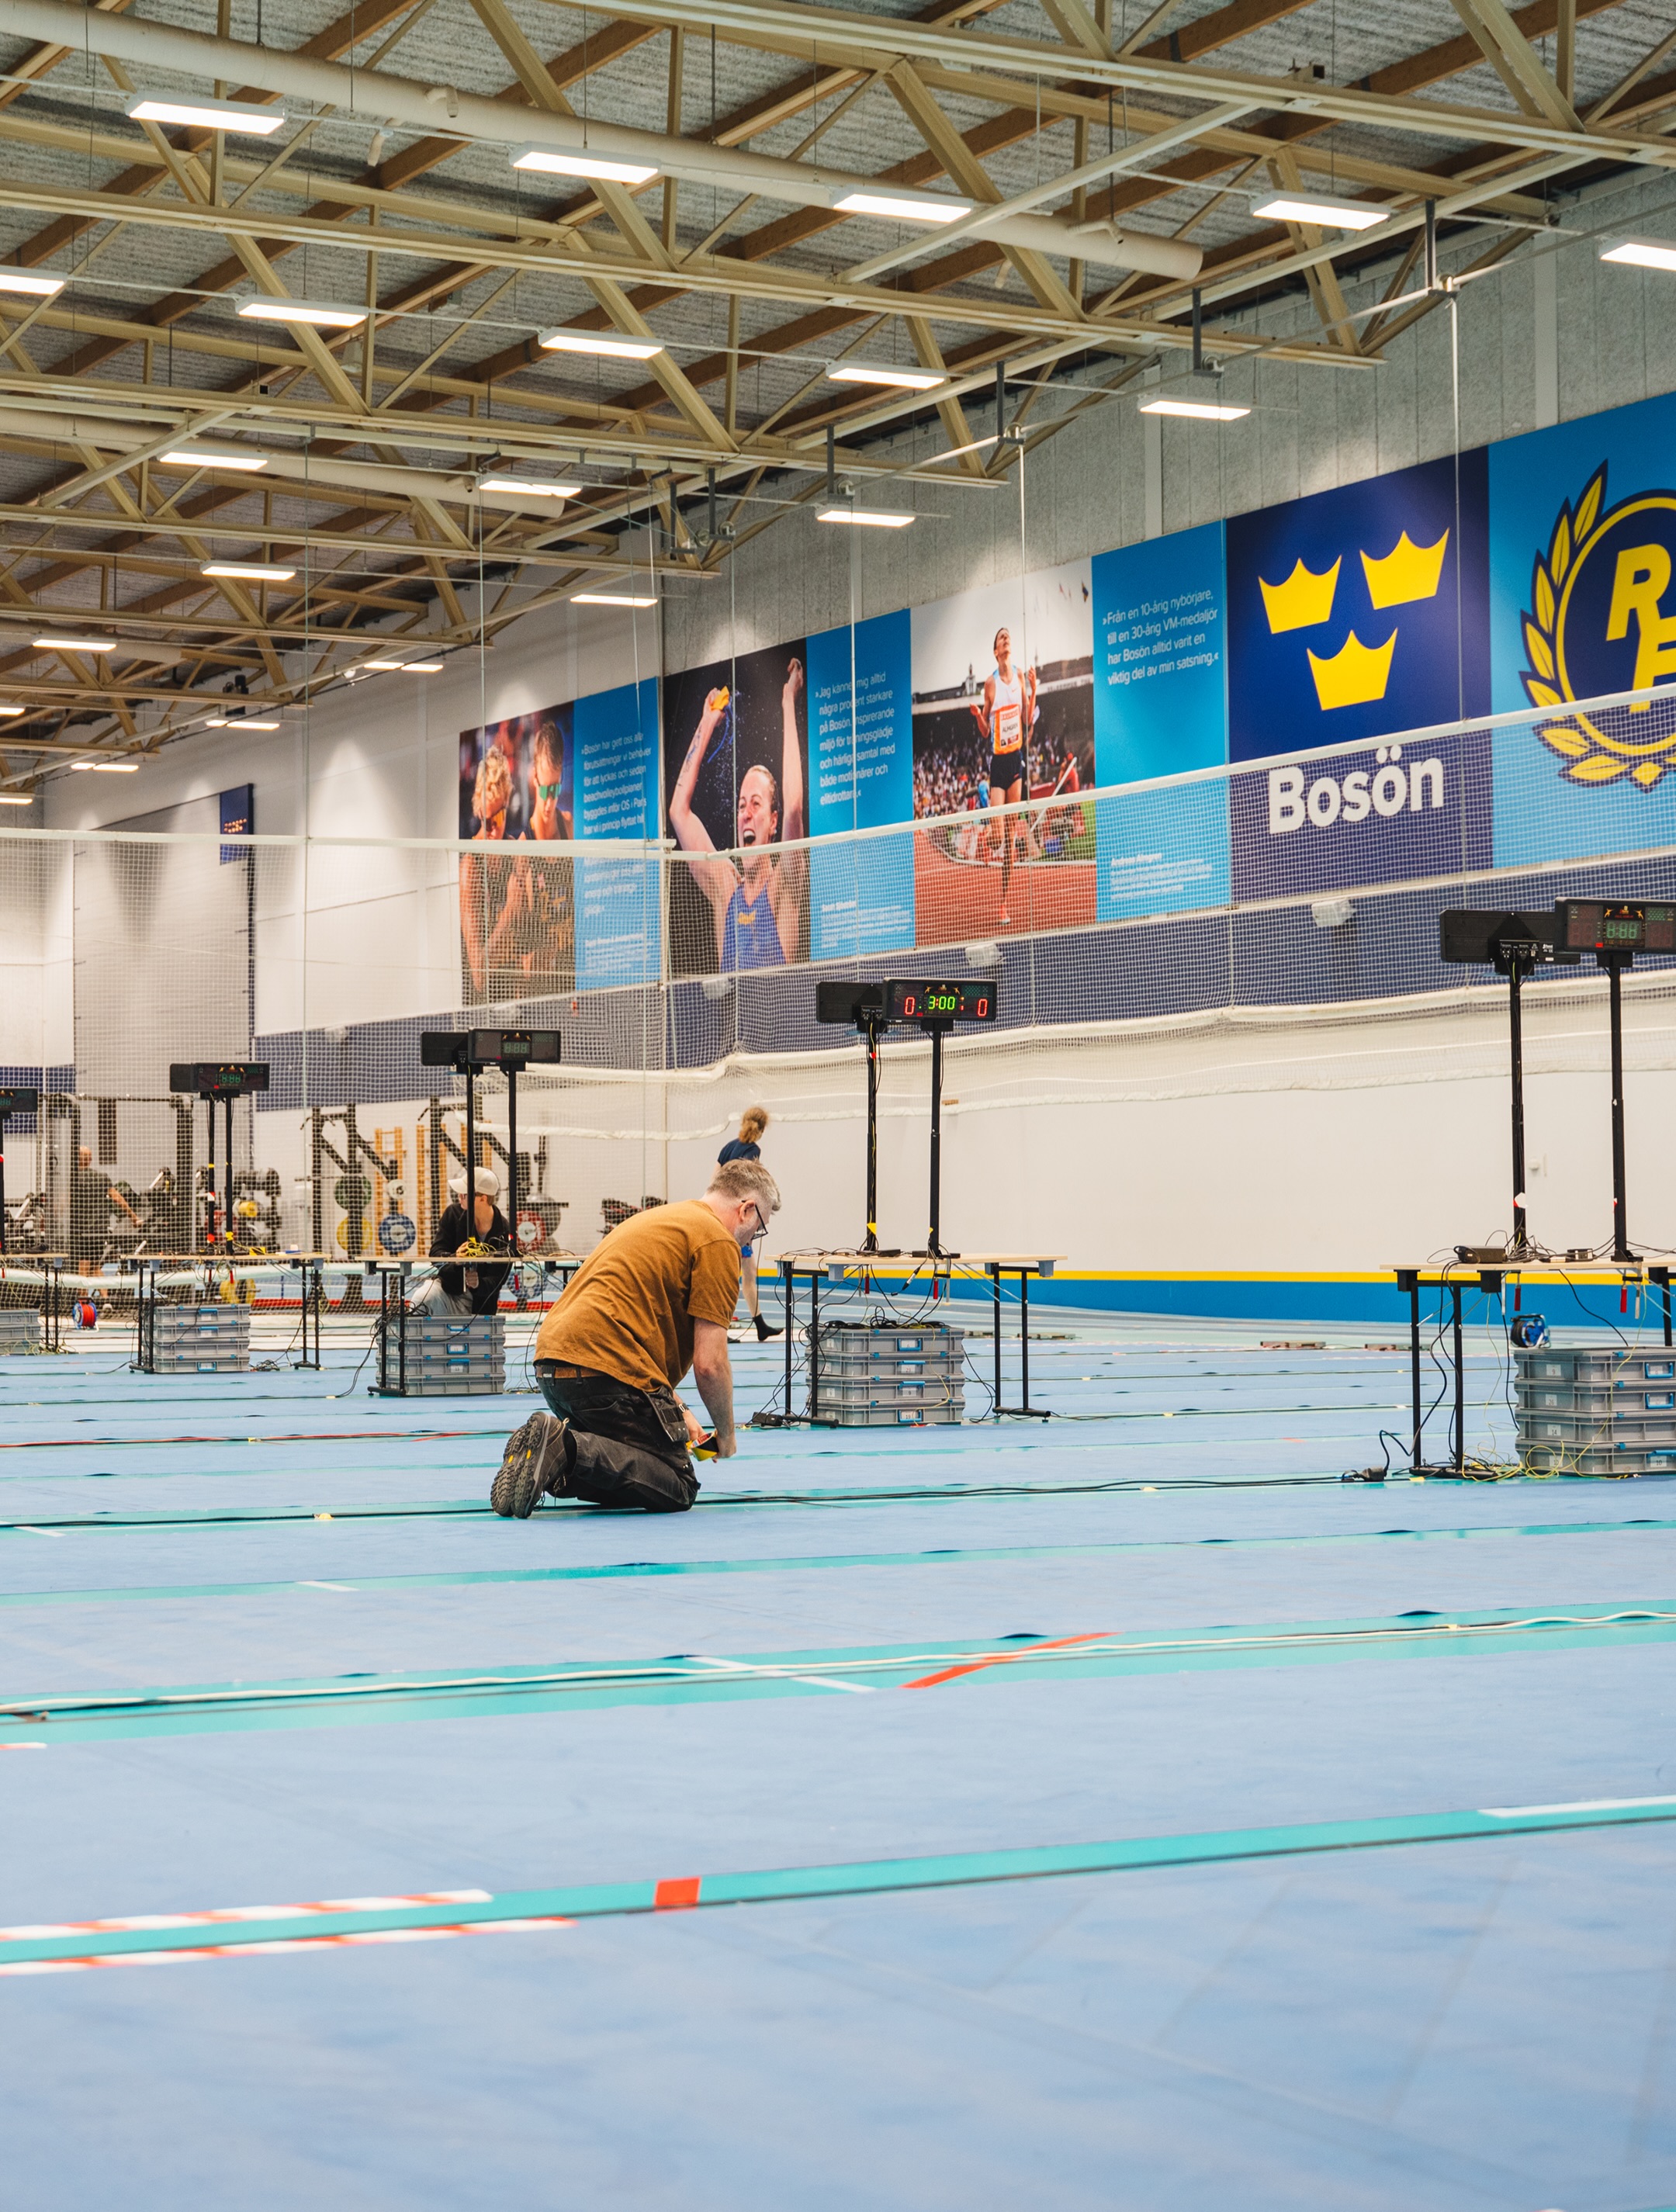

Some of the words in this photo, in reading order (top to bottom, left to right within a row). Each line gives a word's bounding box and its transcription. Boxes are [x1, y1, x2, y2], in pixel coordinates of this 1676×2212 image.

[1128, 608, 1138, 620] en
[1141, 599, 1169, 615] 10-årig
[1170, 590, 1214, 611] nybörjare,
[1107, 632, 1117, 645] till
[1118, 631, 1129, 642] en
[1131, 622, 1161, 639] 30-årig
[1162, 608, 1217, 632] VM-medaljör
[1108, 653, 1121, 665] har
[1123, 645, 1150, 662] Bosön
[1151, 639, 1172, 654] alltid
[1174, 634, 1192, 649] varit
[1193, 633, 1205, 645] en
[832, 681, 854, 694] känne
[856, 677, 869, 689] mig
[870, 671, 886, 684] alltid
[1108, 670, 1130, 685] viktig
[1131, 666, 1145, 680] del
[1147, 666, 1158, 677] av
[1159, 660, 1175, 673] min
[819, 703, 838, 716] några
[866, 690, 893, 704] starkare
[819, 720, 828, 735] på
[829, 717, 852, 731] Bosön.
[854, 707, 895, 725] nspirerande
[819, 738, 836, 752] miljö
[836, 736, 846, 747] för
[847, 725, 893, 745] trningsglädje
[819, 756, 832, 770] och
[857, 746, 878, 761] samtal
[880, 743, 895, 755] med
[819, 774, 837, 788] både
[838, 767, 874, 783] motinärer
[875, 763, 888, 775] och
[1269, 744, 1444, 834] Bosön
[904, 996, 916, 1016] 0
[928, 995, 956, 1010] 3:00
[977, 999, 988, 1016] 0
